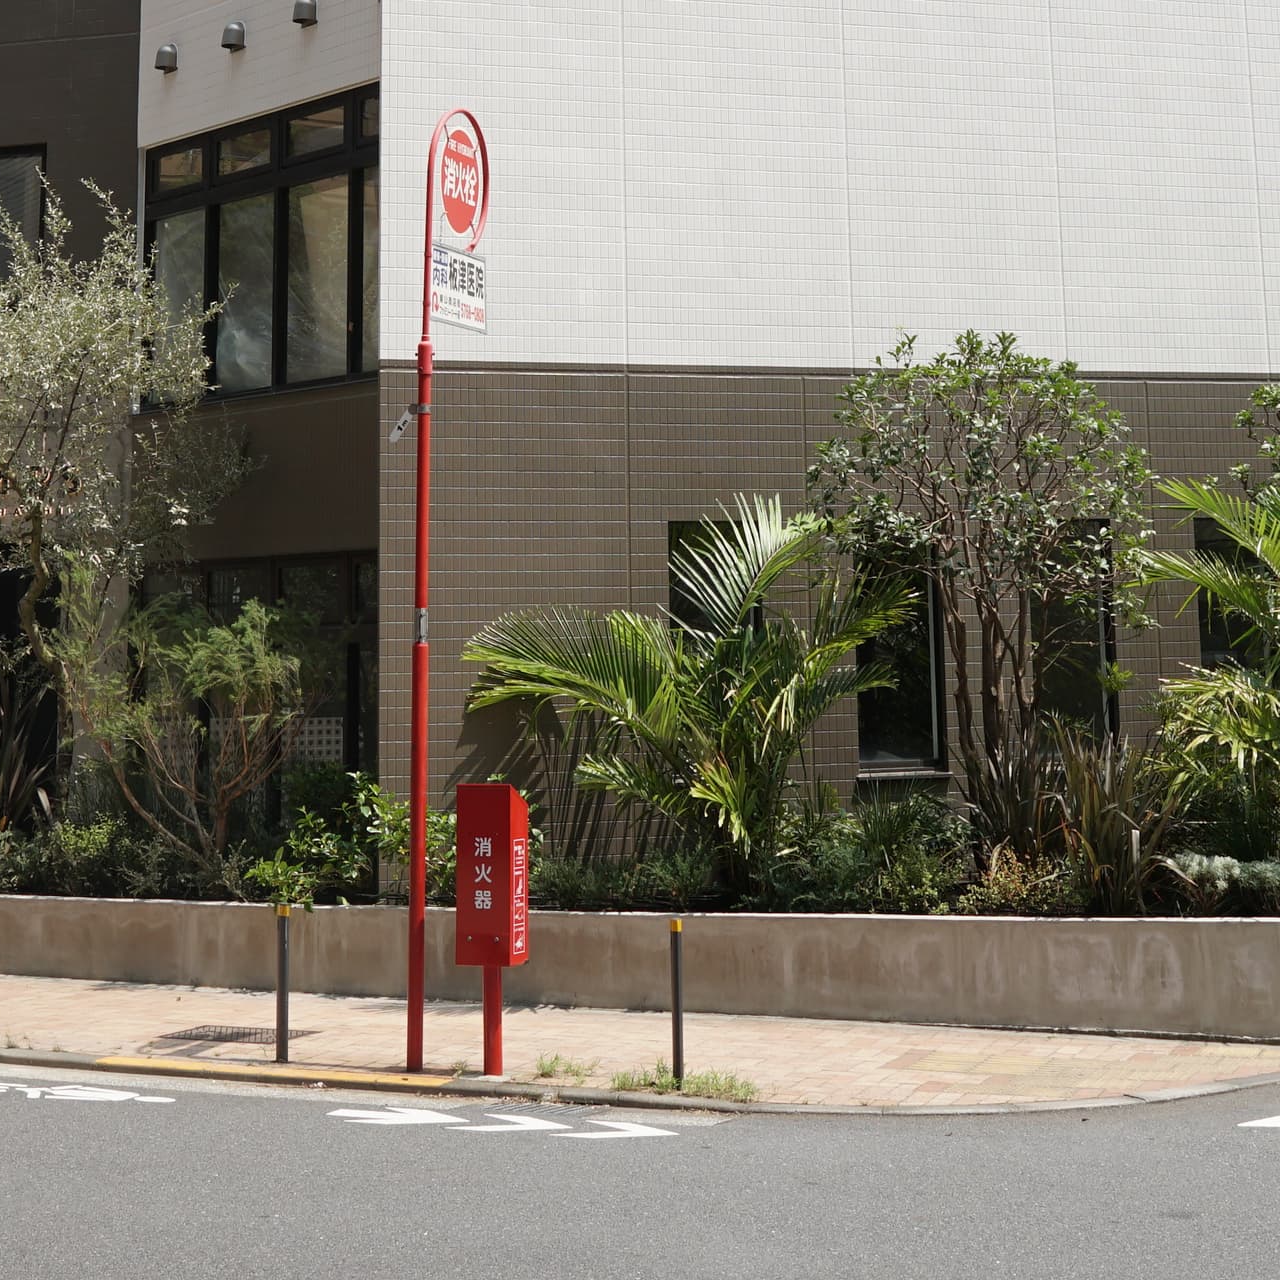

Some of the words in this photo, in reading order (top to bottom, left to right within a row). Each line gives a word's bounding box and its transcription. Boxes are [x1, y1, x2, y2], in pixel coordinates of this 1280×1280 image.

[444, 155, 477, 207] 消火栓
[433, 266, 448, 288] 内科
[449, 256, 484, 300] 板津医院
[474, 837, 492, 910] 消火器
